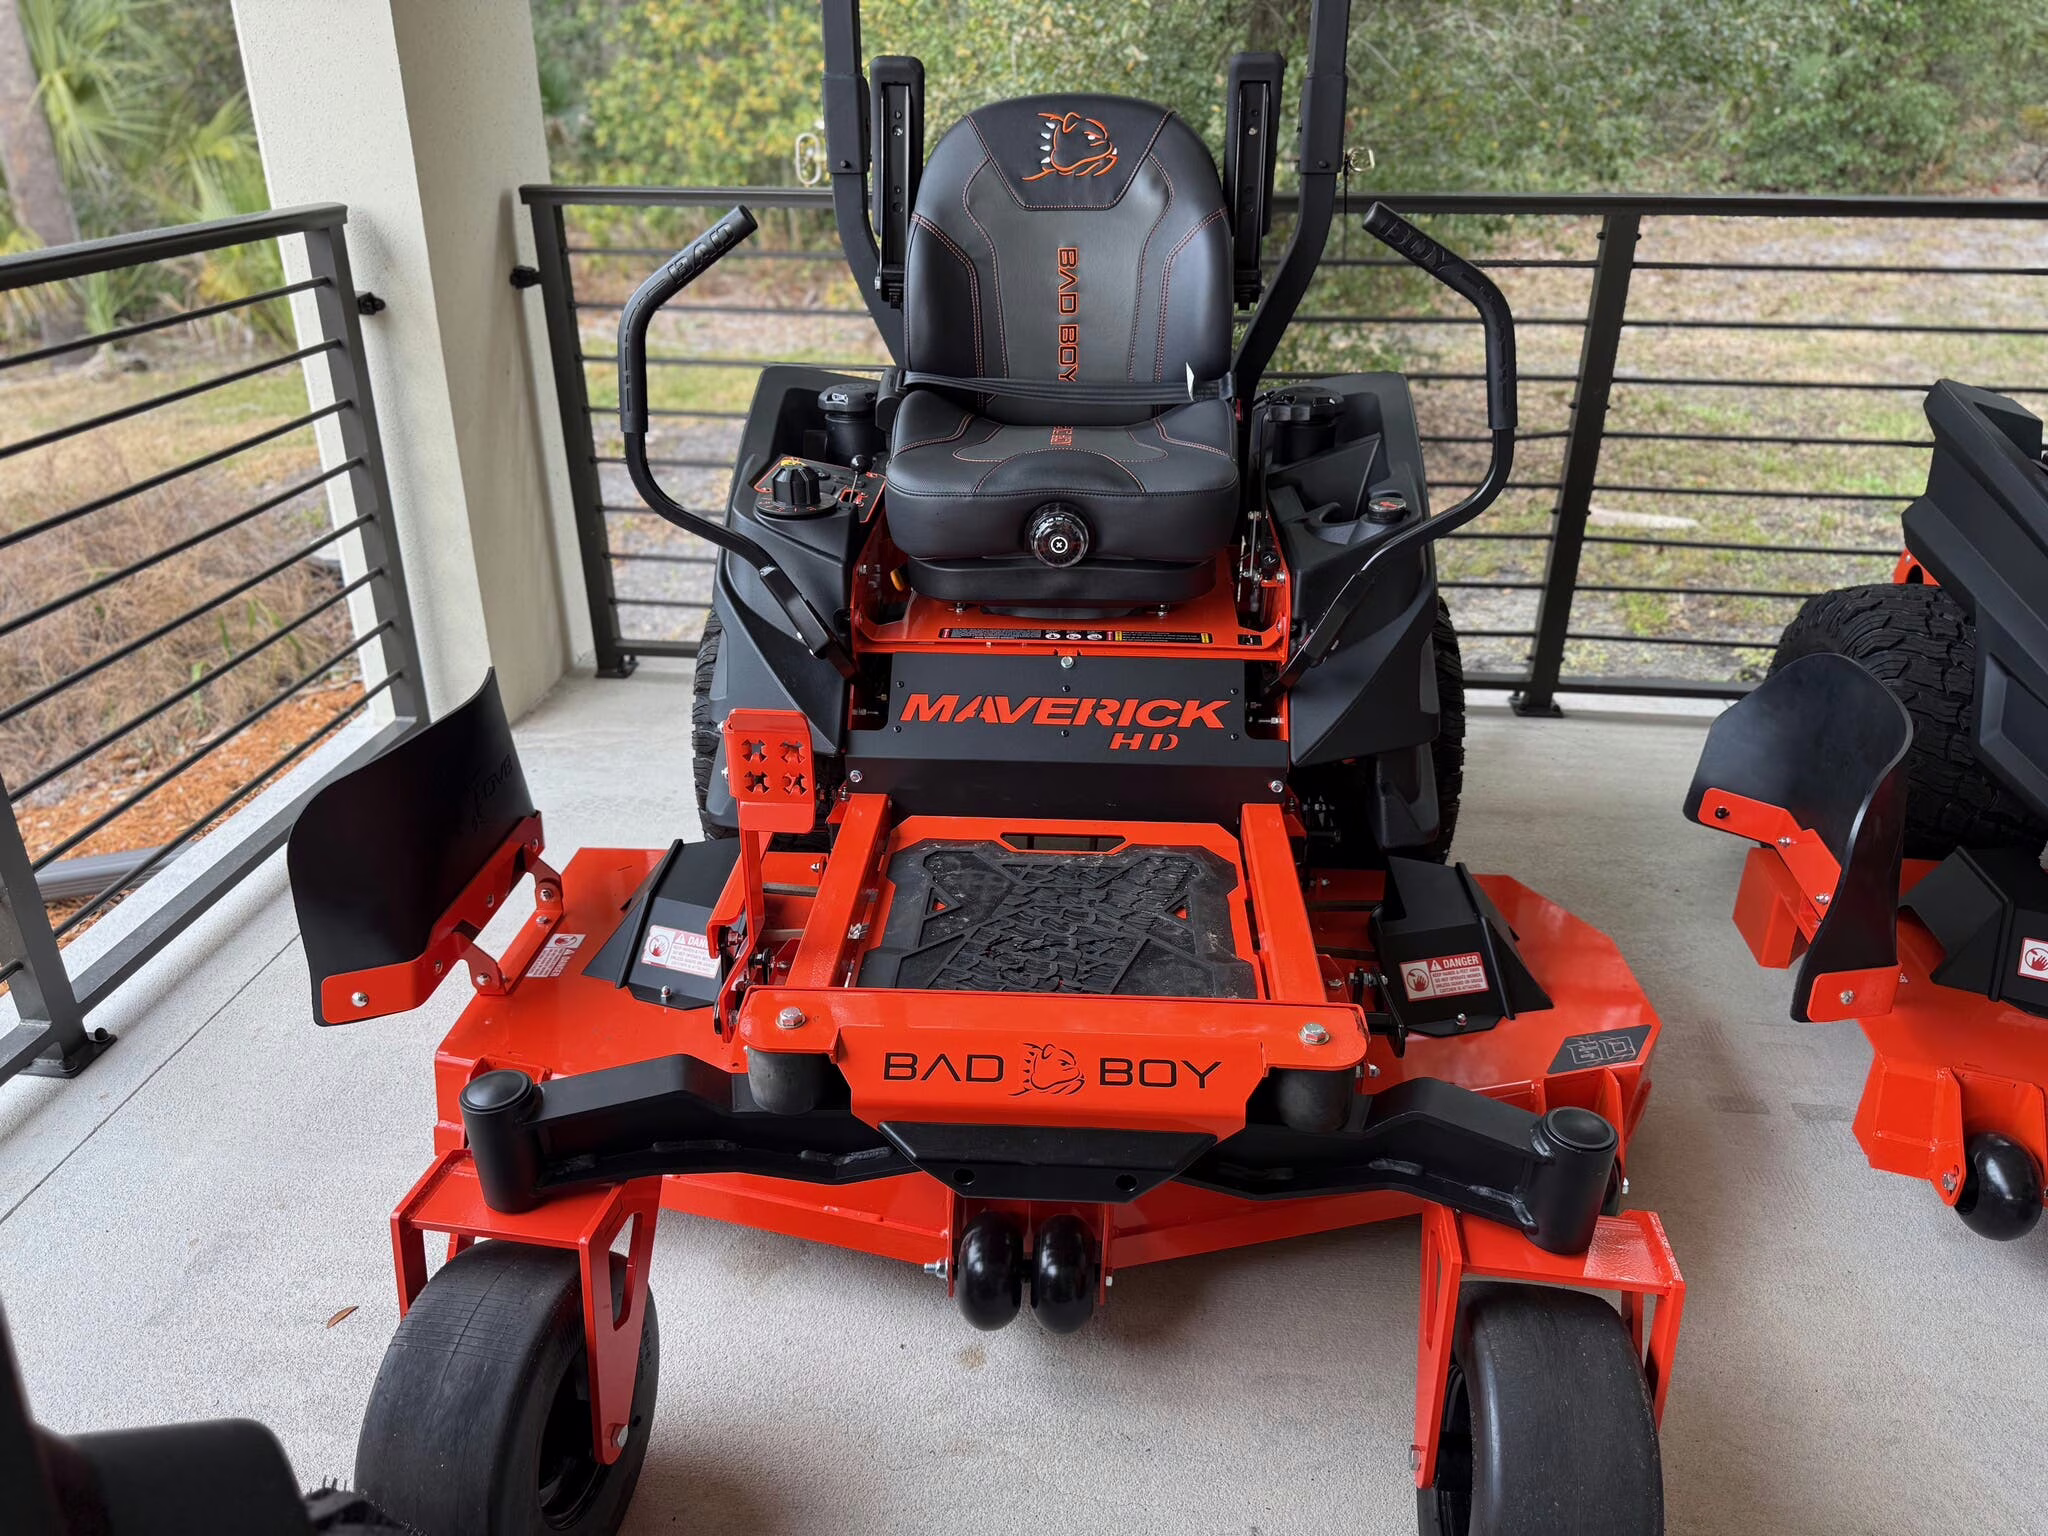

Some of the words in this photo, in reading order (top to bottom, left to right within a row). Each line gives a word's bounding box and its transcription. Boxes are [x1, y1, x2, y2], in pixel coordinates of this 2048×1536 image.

[1058, 247, 1078, 315] BAD
[1058, 324, 1079, 382] BOY
[900, 693, 1231, 729] MAVERICK
[1109, 732, 1179, 751] HD
[1443, 956, 1479, 968] DANGER
[883, 1051, 1004, 1083] BAD
[1099, 1057, 1223, 1089] BOY
